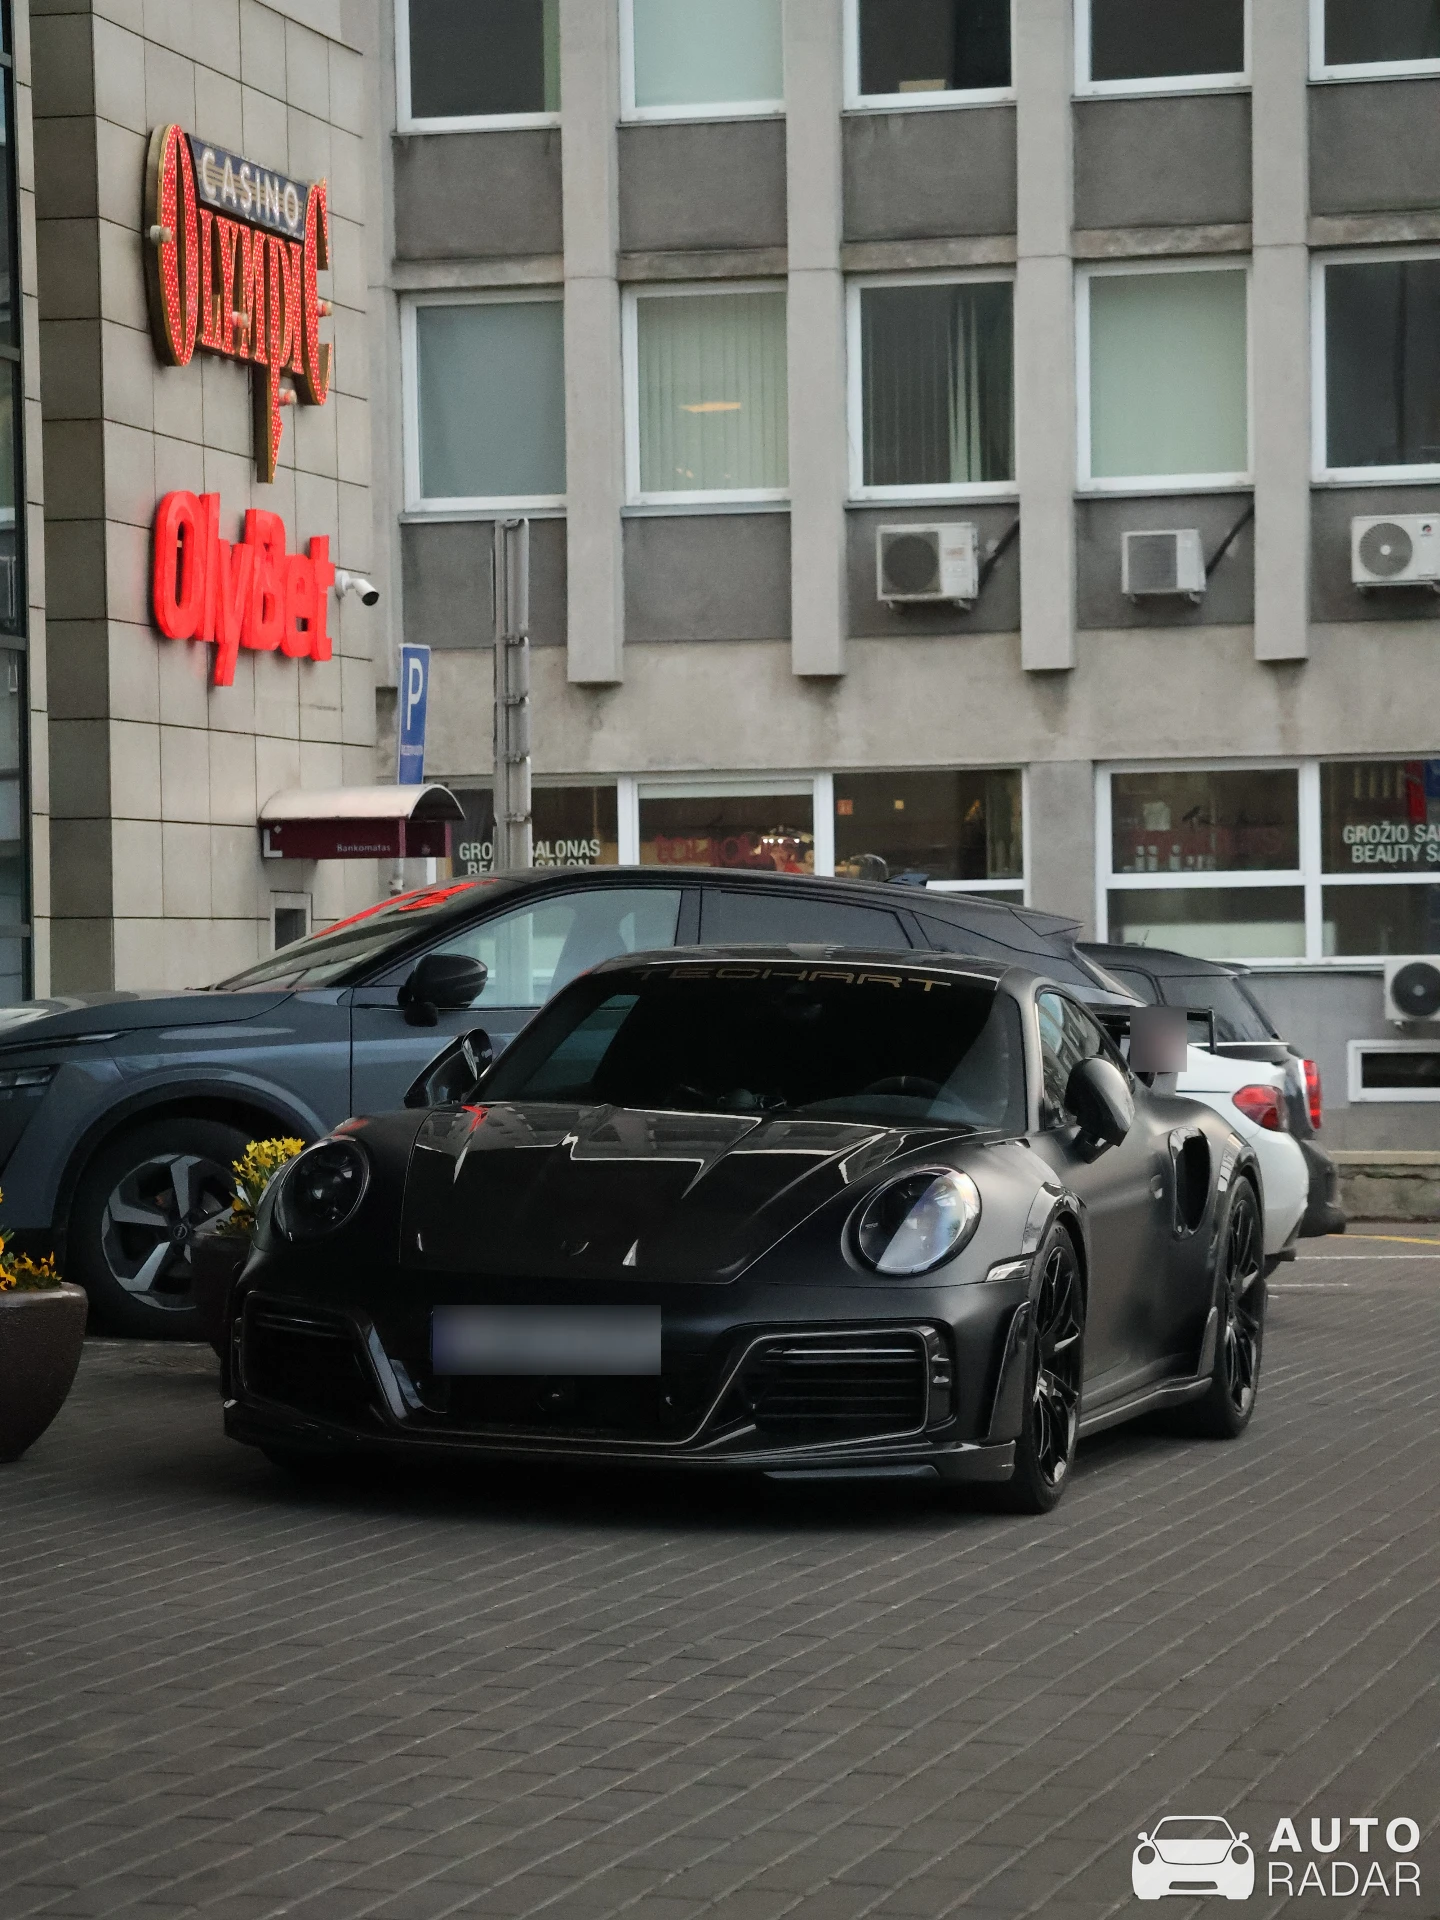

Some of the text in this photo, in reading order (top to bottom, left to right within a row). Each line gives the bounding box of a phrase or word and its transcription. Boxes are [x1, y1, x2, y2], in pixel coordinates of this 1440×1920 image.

[201, 150, 300, 229] CASINO
[154, 490, 335, 686] OlyBet
[406, 657, 424, 731] P
[1342, 820, 1409, 844] GROŽIO
[337, 842, 391, 853] Bankomatas
[459, 838, 601, 861] GRO ALONAS
[1351, 843, 1440, 864] BEAUTY S
[631, 966, 951, 991] TECHART
